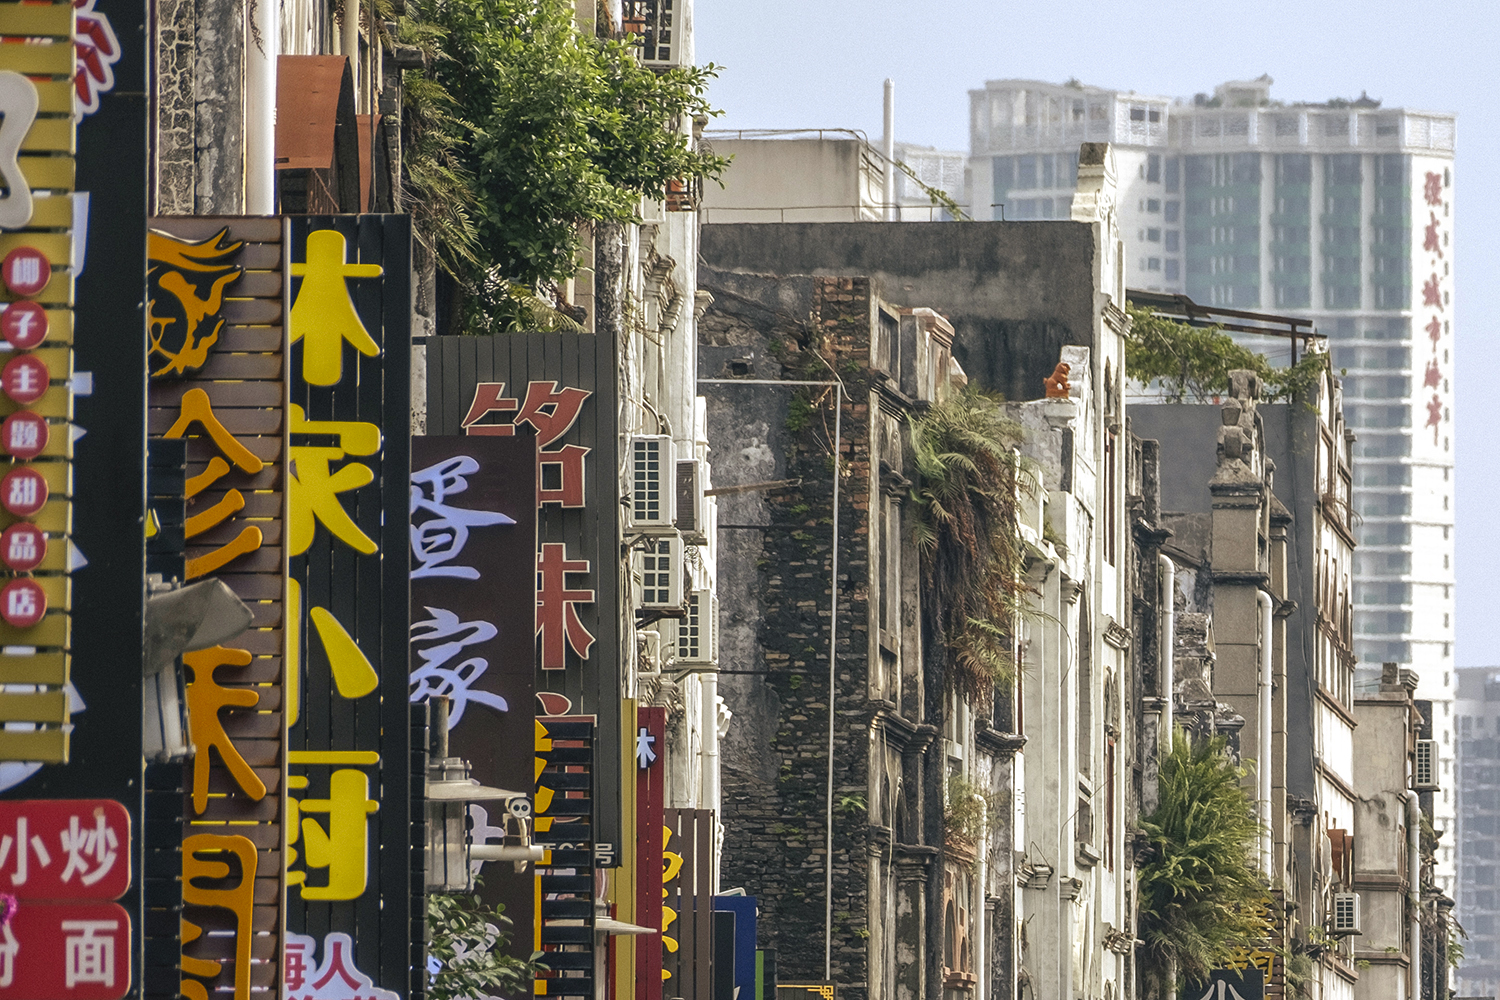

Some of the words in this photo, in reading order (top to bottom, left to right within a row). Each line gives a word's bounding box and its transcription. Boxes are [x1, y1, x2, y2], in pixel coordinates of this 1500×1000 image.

[9, 257, 41, 617] 椰子主题甜品店
[0, 817, 119, 886] 小炒
